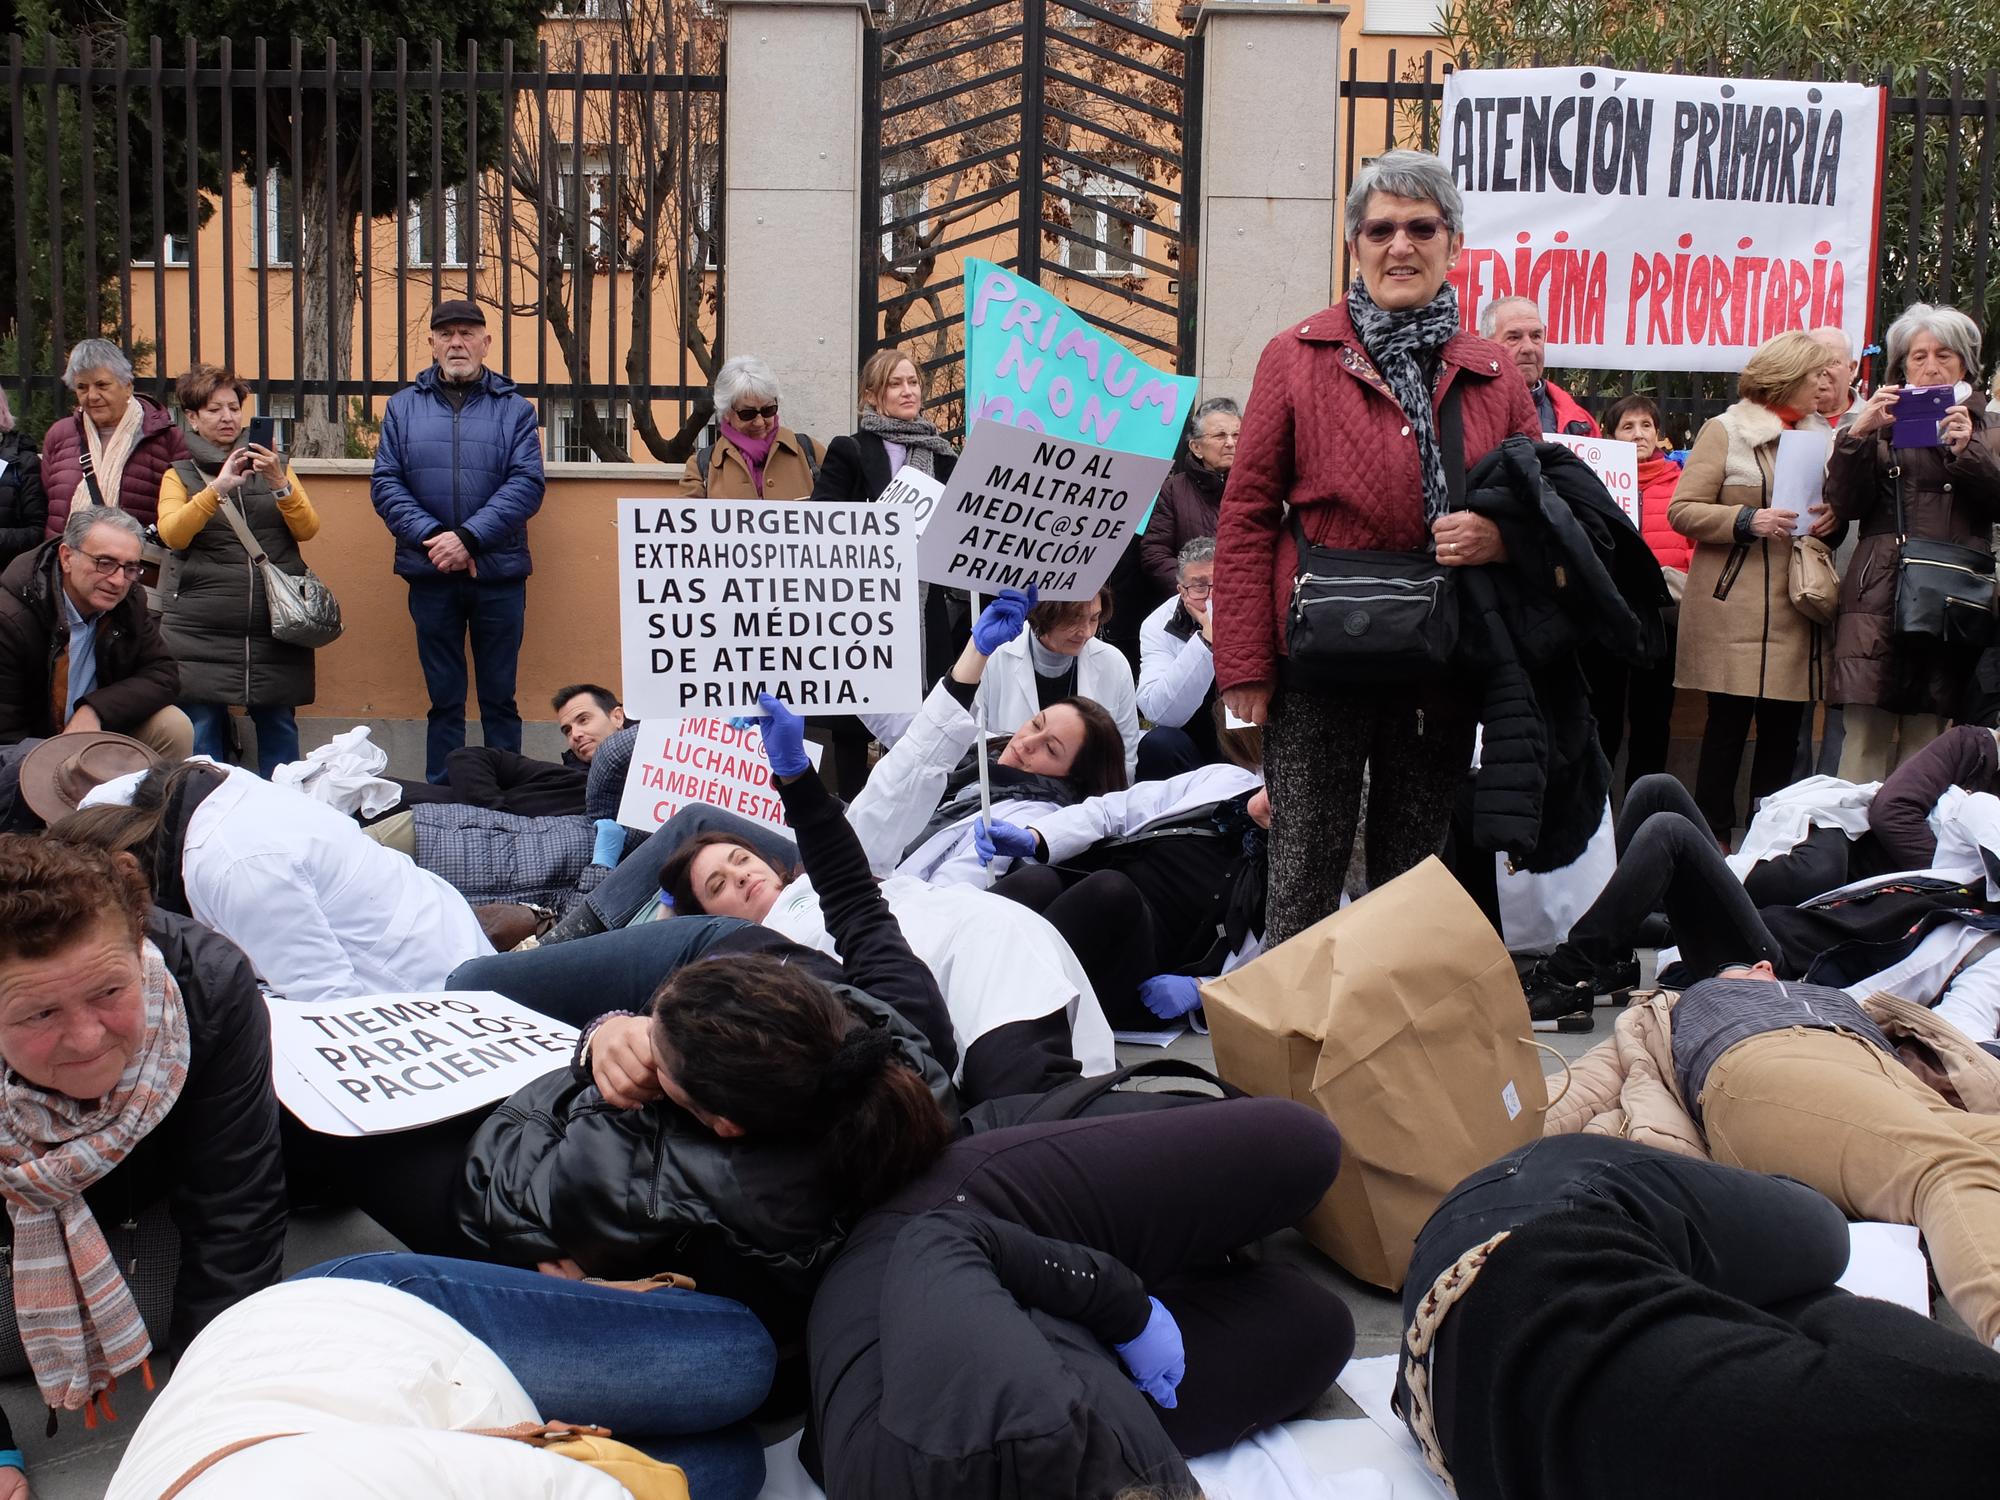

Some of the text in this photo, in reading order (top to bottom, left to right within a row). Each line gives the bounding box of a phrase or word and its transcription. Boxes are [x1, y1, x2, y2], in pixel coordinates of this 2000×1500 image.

[1451, 72, 1843, 207] ATENCIÓN PRIMARIA
[1625, 233, 1844, 347] PRIORITARIA
[971, 272, 1179, 426] PRIMUM
[996, 335, 1121, 444] NON
[1032, 442, 1113, 479] NO AL
[985, 465, 1129, 511] MALTRATO
[634, 508, 901, 536] LAS URGENCIAS
[956, 491, 1127, 540] MEDIC@S DE
[635, 543, 902, 573] EXTRAHOSPITALARIAS,
[959, 525, 1098, 565] ATENCIÓN
[637, 578, 901, 604] LAS ATIENDEN
[947, 553, 1078, 591] PRIMARIA
[648, 606, 895, 638] SUS MÉDICOS
[651, 639, 894, 674] DE ATENCIÓN
[679, 679, 870, 708] PRIMARIA.
[642, 763, 789, 826] TAMBIÉN ESTÁ
[300, 999, 480, 1040] TIEMPO
[314, 1015, 538, 1072] PARA LOS
[336, 1031, 580, 1104] PACIENTES
